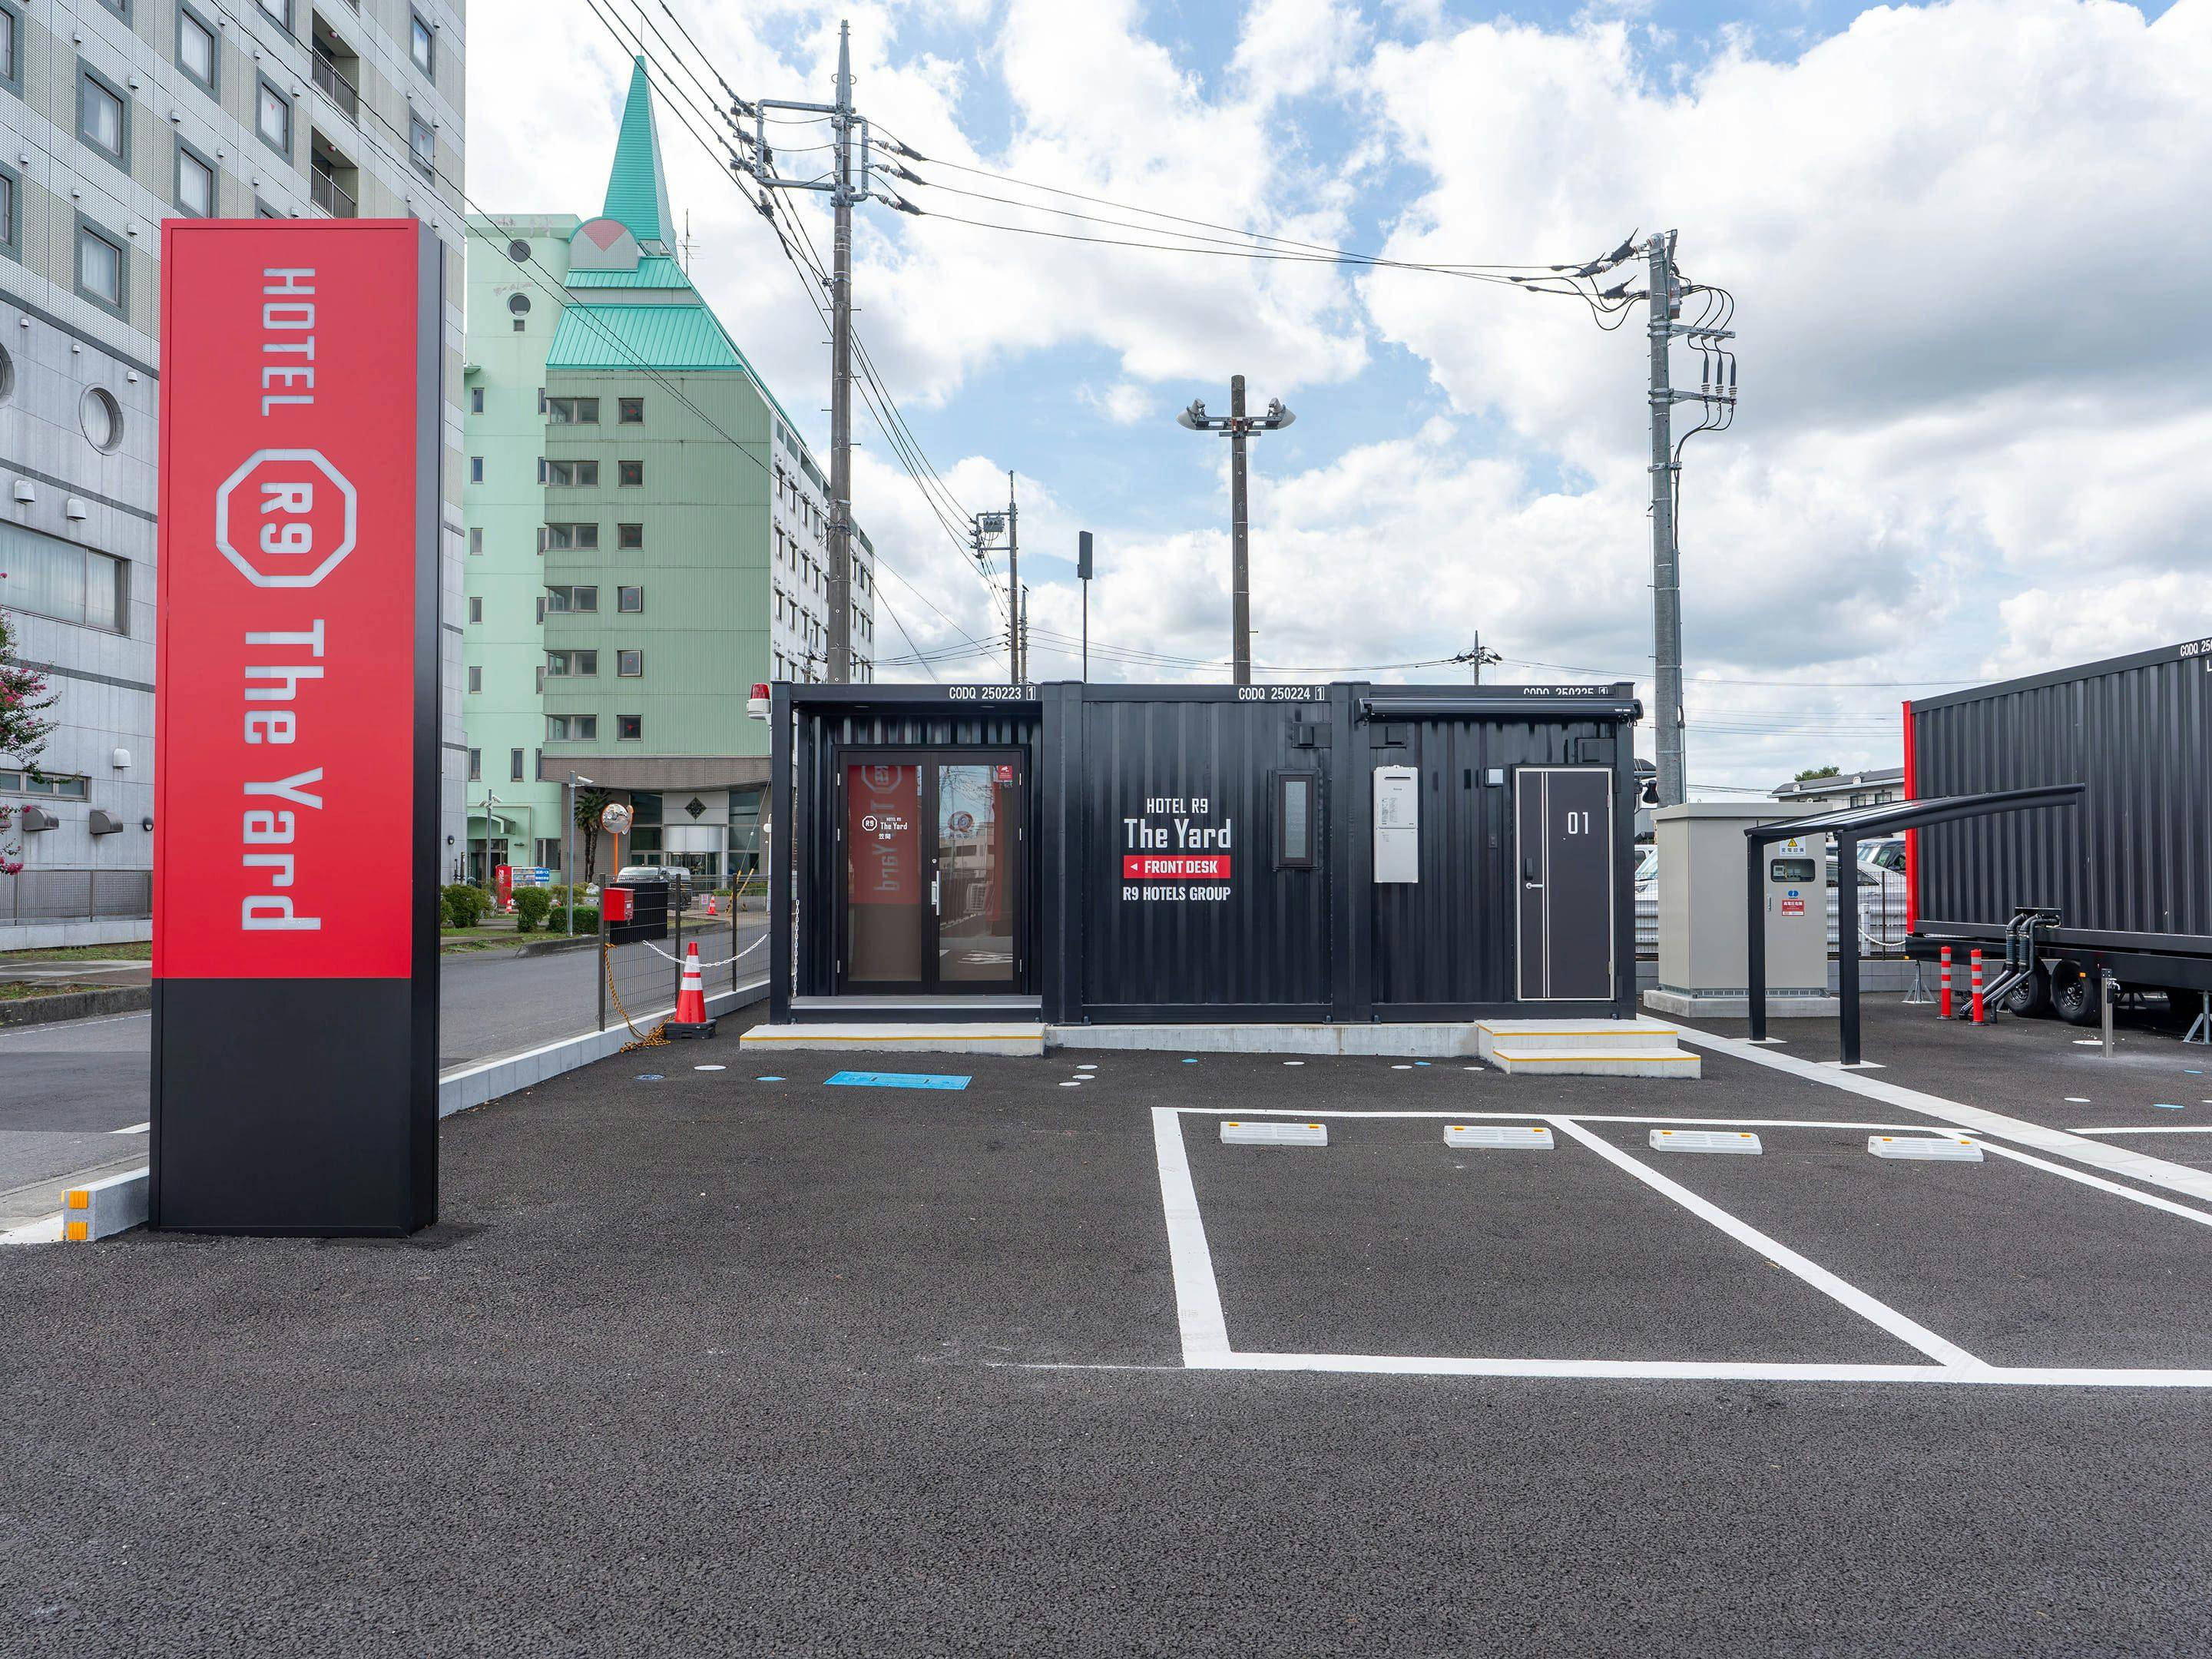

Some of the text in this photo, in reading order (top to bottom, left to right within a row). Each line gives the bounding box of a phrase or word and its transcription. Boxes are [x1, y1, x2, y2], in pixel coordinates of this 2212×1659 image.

[262, 268, 316, 416] HOTEL
[260, 482, 313, 554] R9
[2181, 643, 2198, 657] CODQ
[949, 687, 976, 700] CODQ
[982, 687, 1022, 700] 250223
[1238, 687, 1266, 700] CODQ
[1271, 687, 1311, 700] 250224
[241, 619, 325, 930] The Yard
[1147, 798, 1208, 813] HOTEL R9
[880, 822, 908, 830] The Yard
[1568, 811, 1588, 834] 01
[1124, 818, 1231, 849] The Yard
[1144, 860, 1218, 874] FRONT DESK
[1123, 886, 1231, 901] R9 HOTELS GROUP
